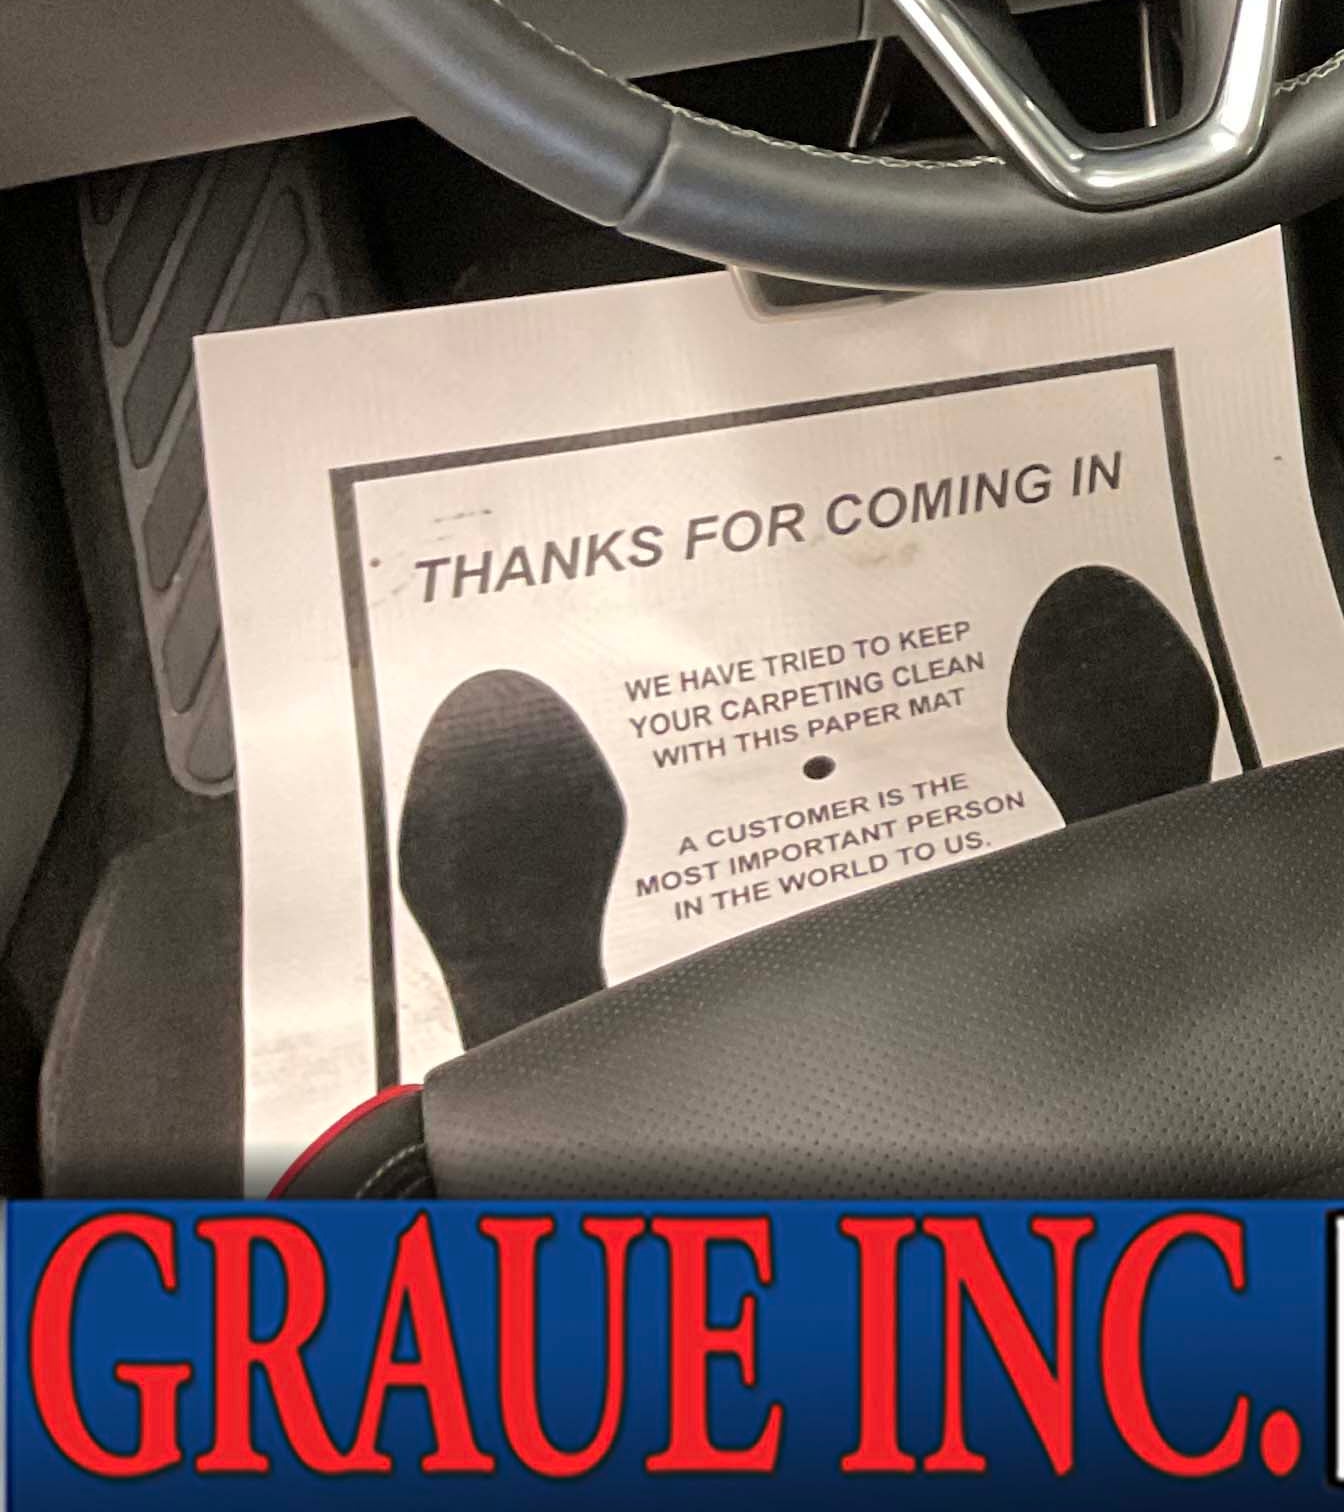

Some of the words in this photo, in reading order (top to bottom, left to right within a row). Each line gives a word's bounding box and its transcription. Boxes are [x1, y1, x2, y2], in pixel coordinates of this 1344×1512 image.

[415, 524, 665, 605] THANKS
[684, 502, 807, 561] FOR
[824, 462, 1053, 536] COMING
[1071, 450, 1123, 498] IN
[625, 674, 672, 702] WE
[680, 659, 754, 693] HAVE
[763, 644, 845, 678] TRIED
[853, 635, 890, 660] TO
[900, 620, 971, 651] KEEP
[629, 704, 712, 739] YOUR
[720, 672, 883, 722] CARPETING
[893, 651, 984, 687] CLEAN
[653, 737, 726, 769] WITH
[733, 723, 799, 753] THIS
[807, 702, 901, 739] PAPER
[909, 687, 965, 717] MAT
[636, 861, 721, 898] MOST
[729, 819, 898, 877] IMPORTANT
[907, 791, 1026, 834] PERSON
[678, 836, 698, 856] A
[706, 795, 869, 848] CUSTOMER
[878, 787, 905, 808] IS
[911, 772, 970, 802] THE
[674, 899, 704, 921] IN
[711, 881, 772, 911] THE
[778, 853, 889, 895] WORLD
[897, 842, 935, 867] TO
[944, 830, 991, 856] US.
